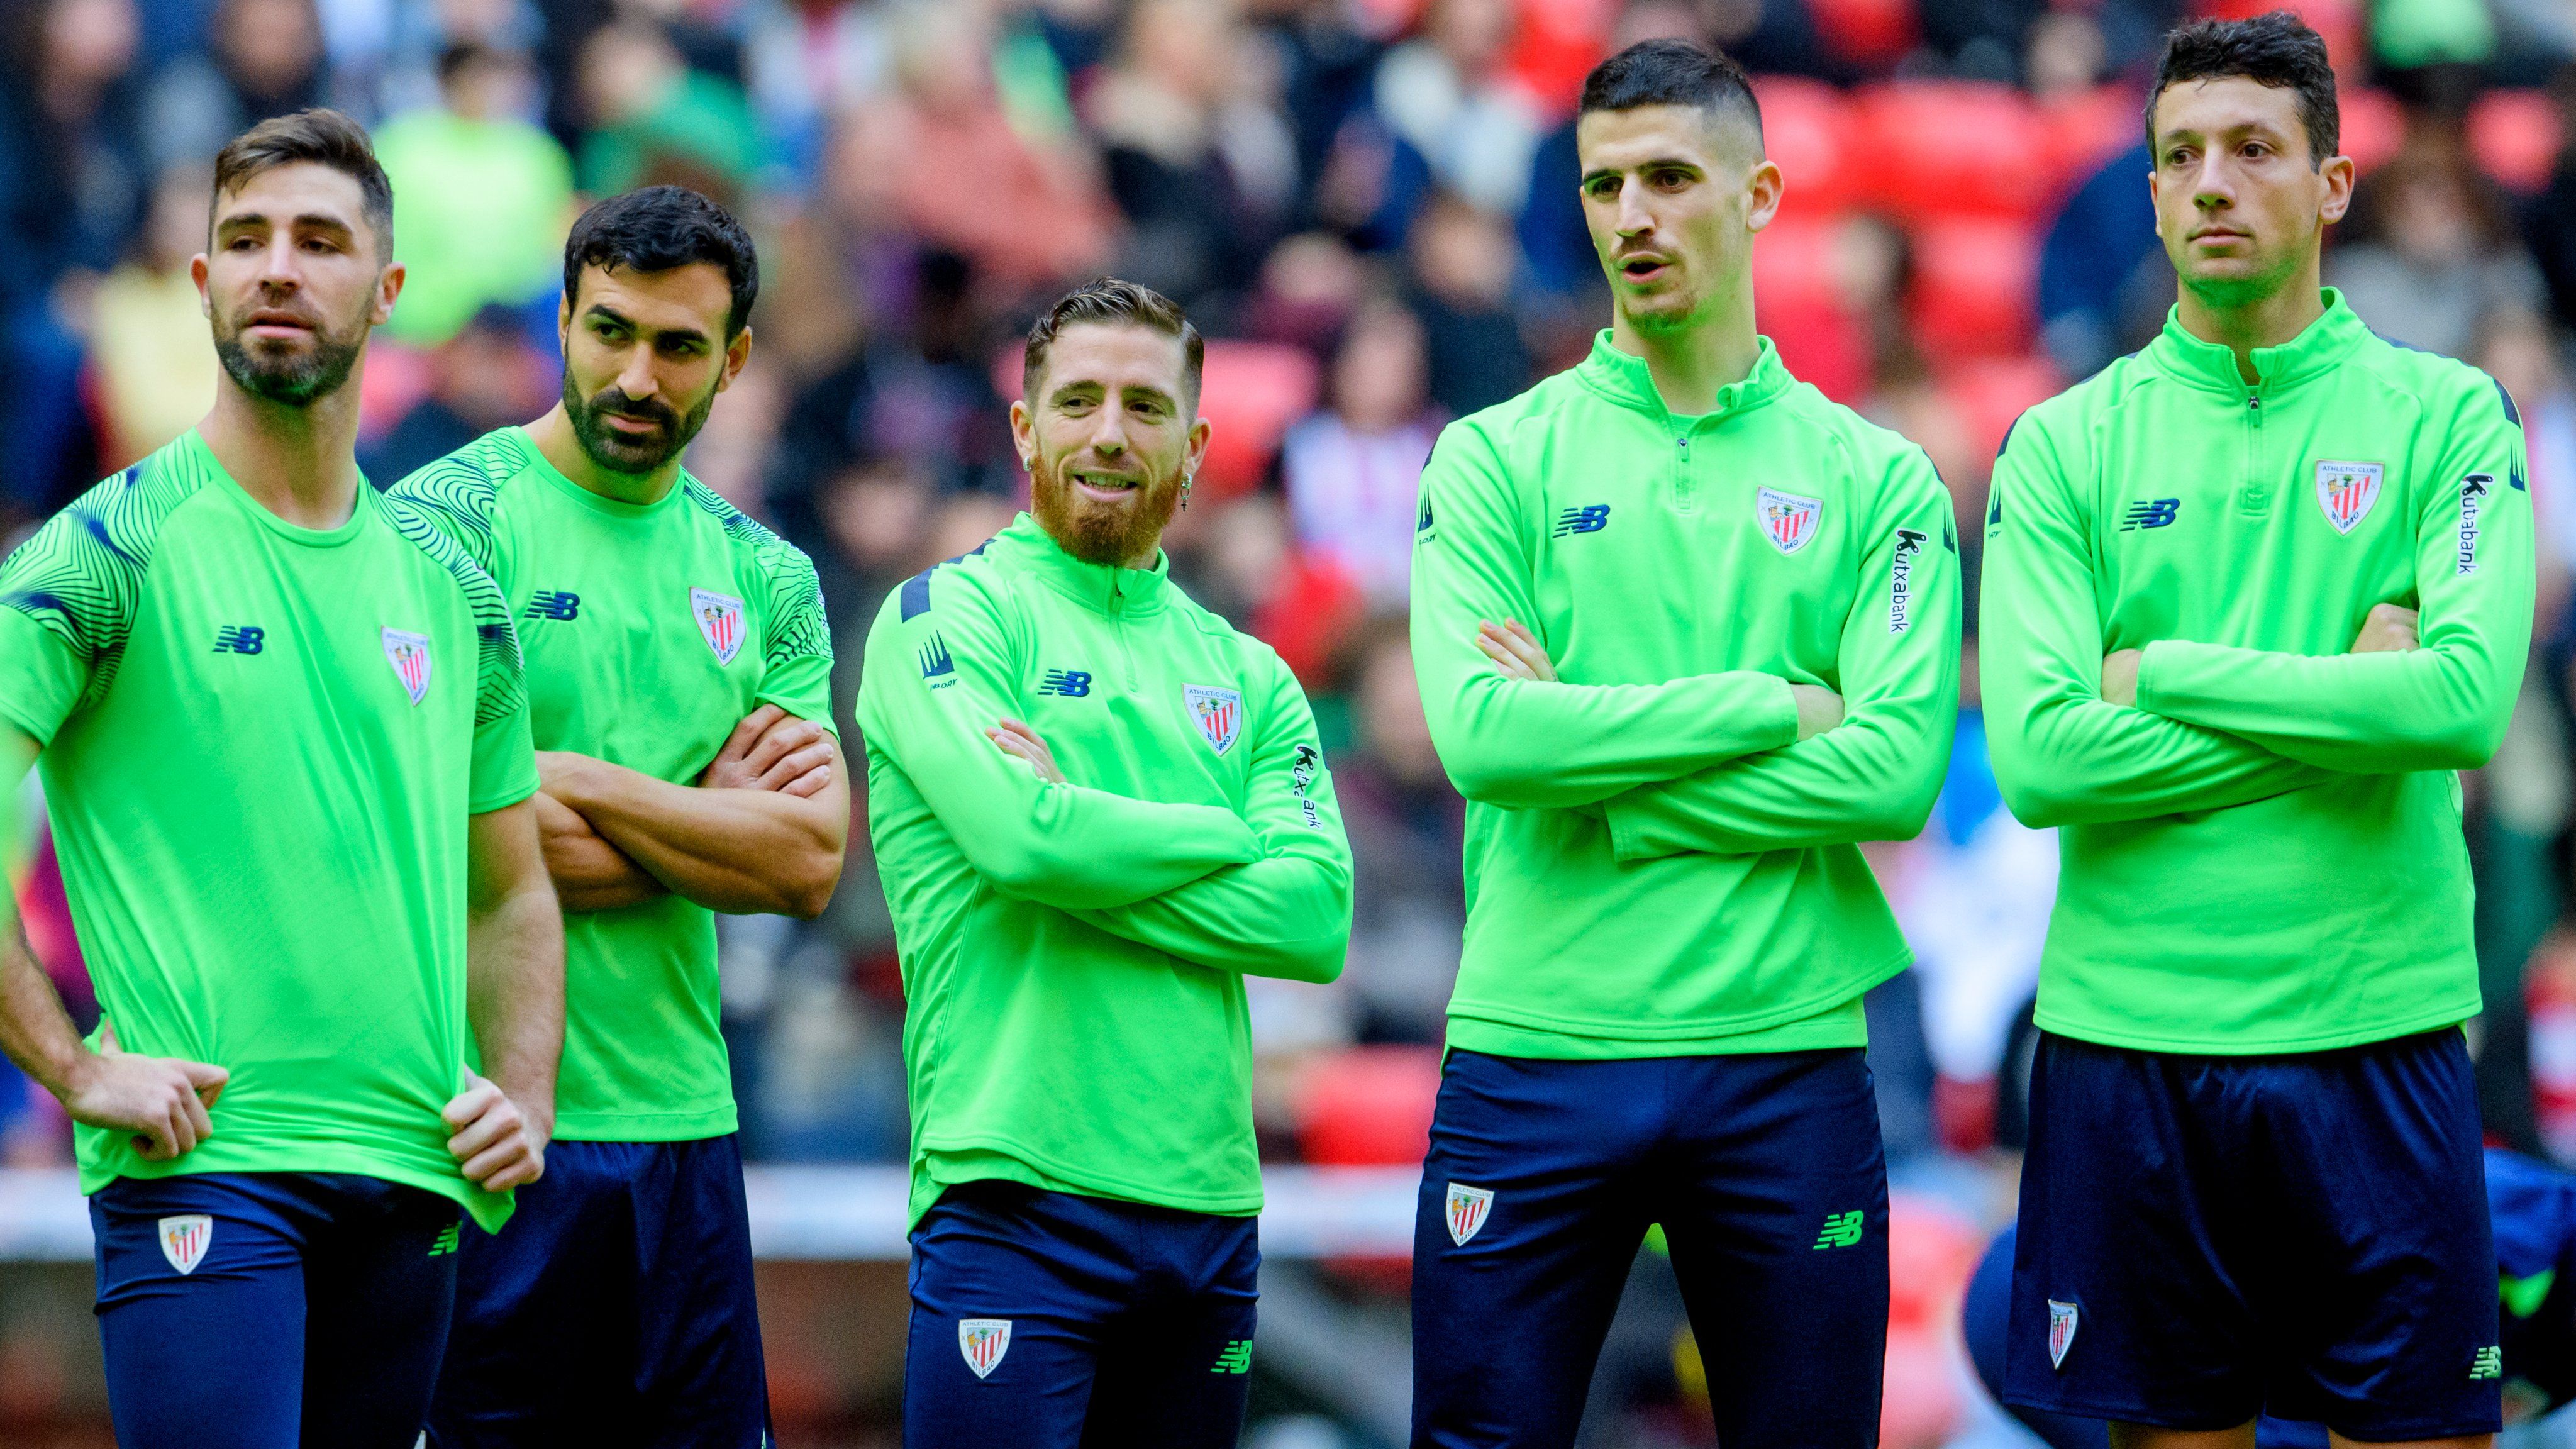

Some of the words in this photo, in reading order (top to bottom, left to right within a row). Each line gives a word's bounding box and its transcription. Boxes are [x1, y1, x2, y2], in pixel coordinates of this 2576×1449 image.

[1763, 492, 1796, 504] ATHLETIC
[1797, 501, 1816, 509] CLUB
[2331, 509, 2360, 529] BILBAO
[1772, 533, 1799, 550] BILBAO
[1890, 530, 1927, 633] Kutxabank
[696, 594, 724, 604] ATHLETIC
[725, 601, 740, 609] CLUB
[712, 640, 735, 660] BILBAO
[1189, 689, 1220, 697] ATHLETIC
[1221, 692, 1238, 701] CLUB
[1207, 731, 1230, 750] BILBAO
[972, 1360, 995, 1376] BILBAO
